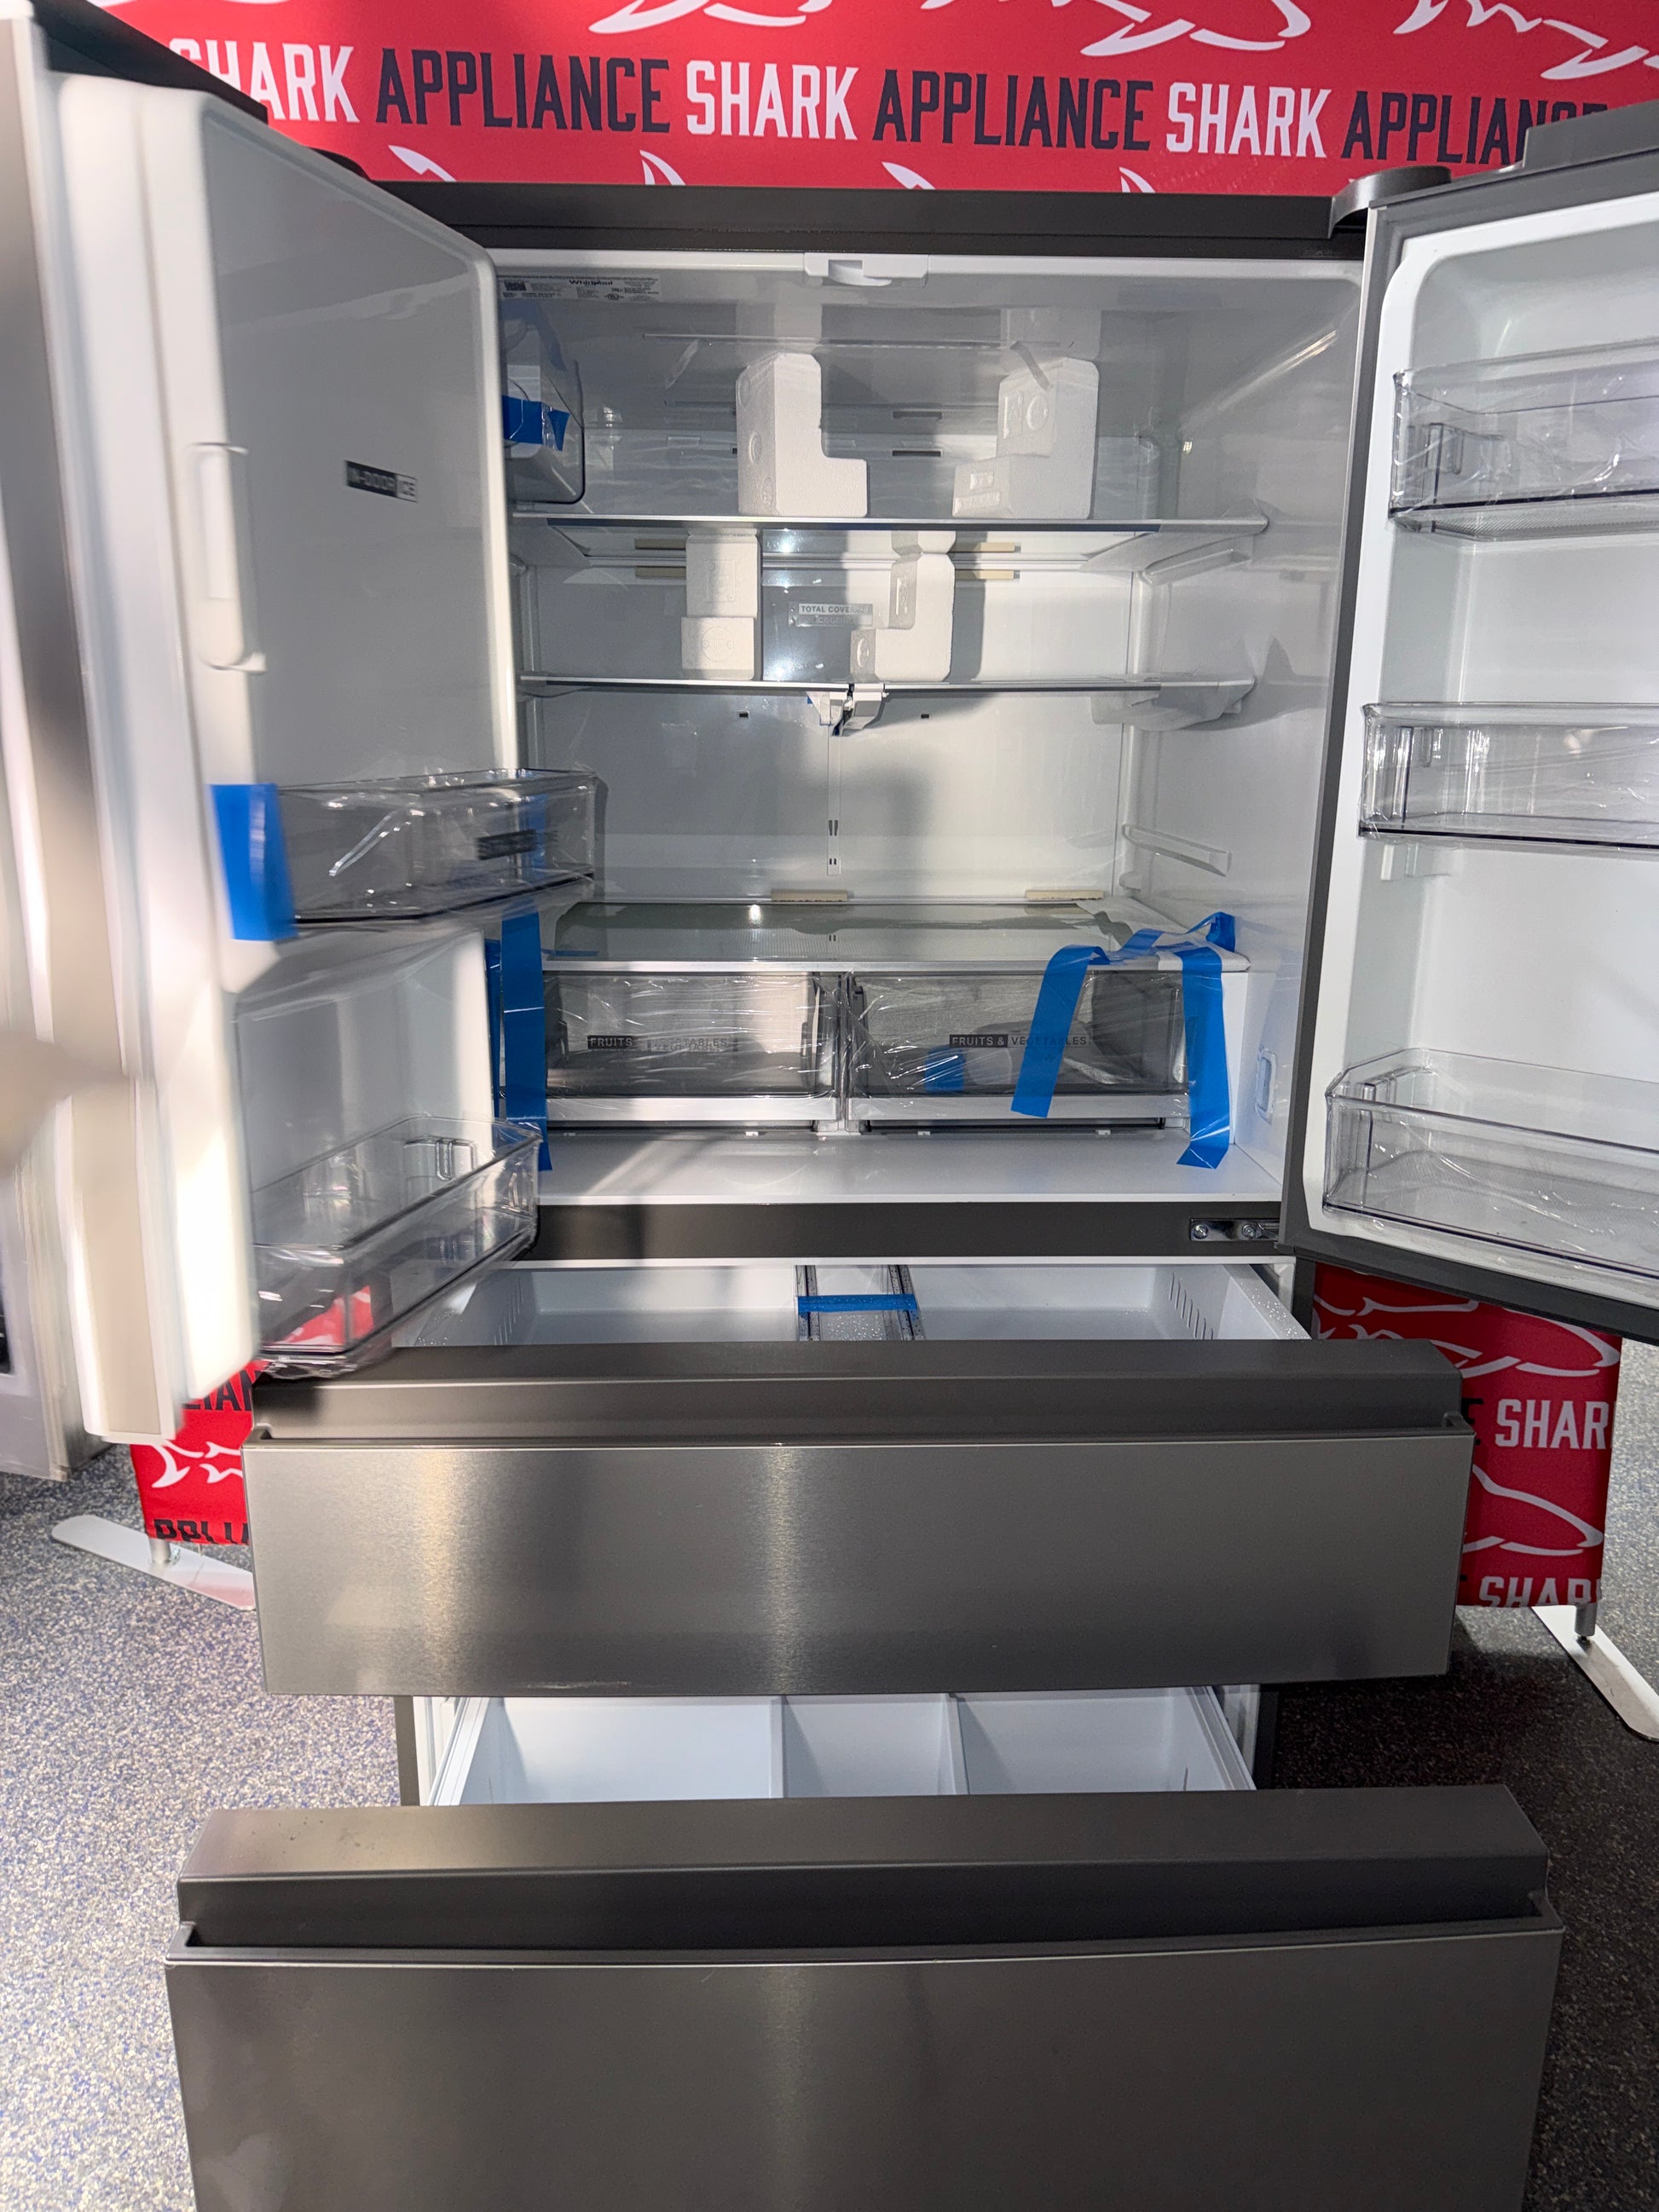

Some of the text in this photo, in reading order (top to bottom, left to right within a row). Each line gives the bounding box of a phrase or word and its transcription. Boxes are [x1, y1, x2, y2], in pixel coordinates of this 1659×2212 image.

[170, 38, 1608, 165] HARK APPLIANCE SHARK APPLIANCE SHARK APPLIAN
[589, 1037, 633, 1047] FRUITS
[951, 1037, 994, 1046] FRUITS
[997, 1037, 1006, 1046] &
[1494, 1398, 1616, 1450] SHAR
